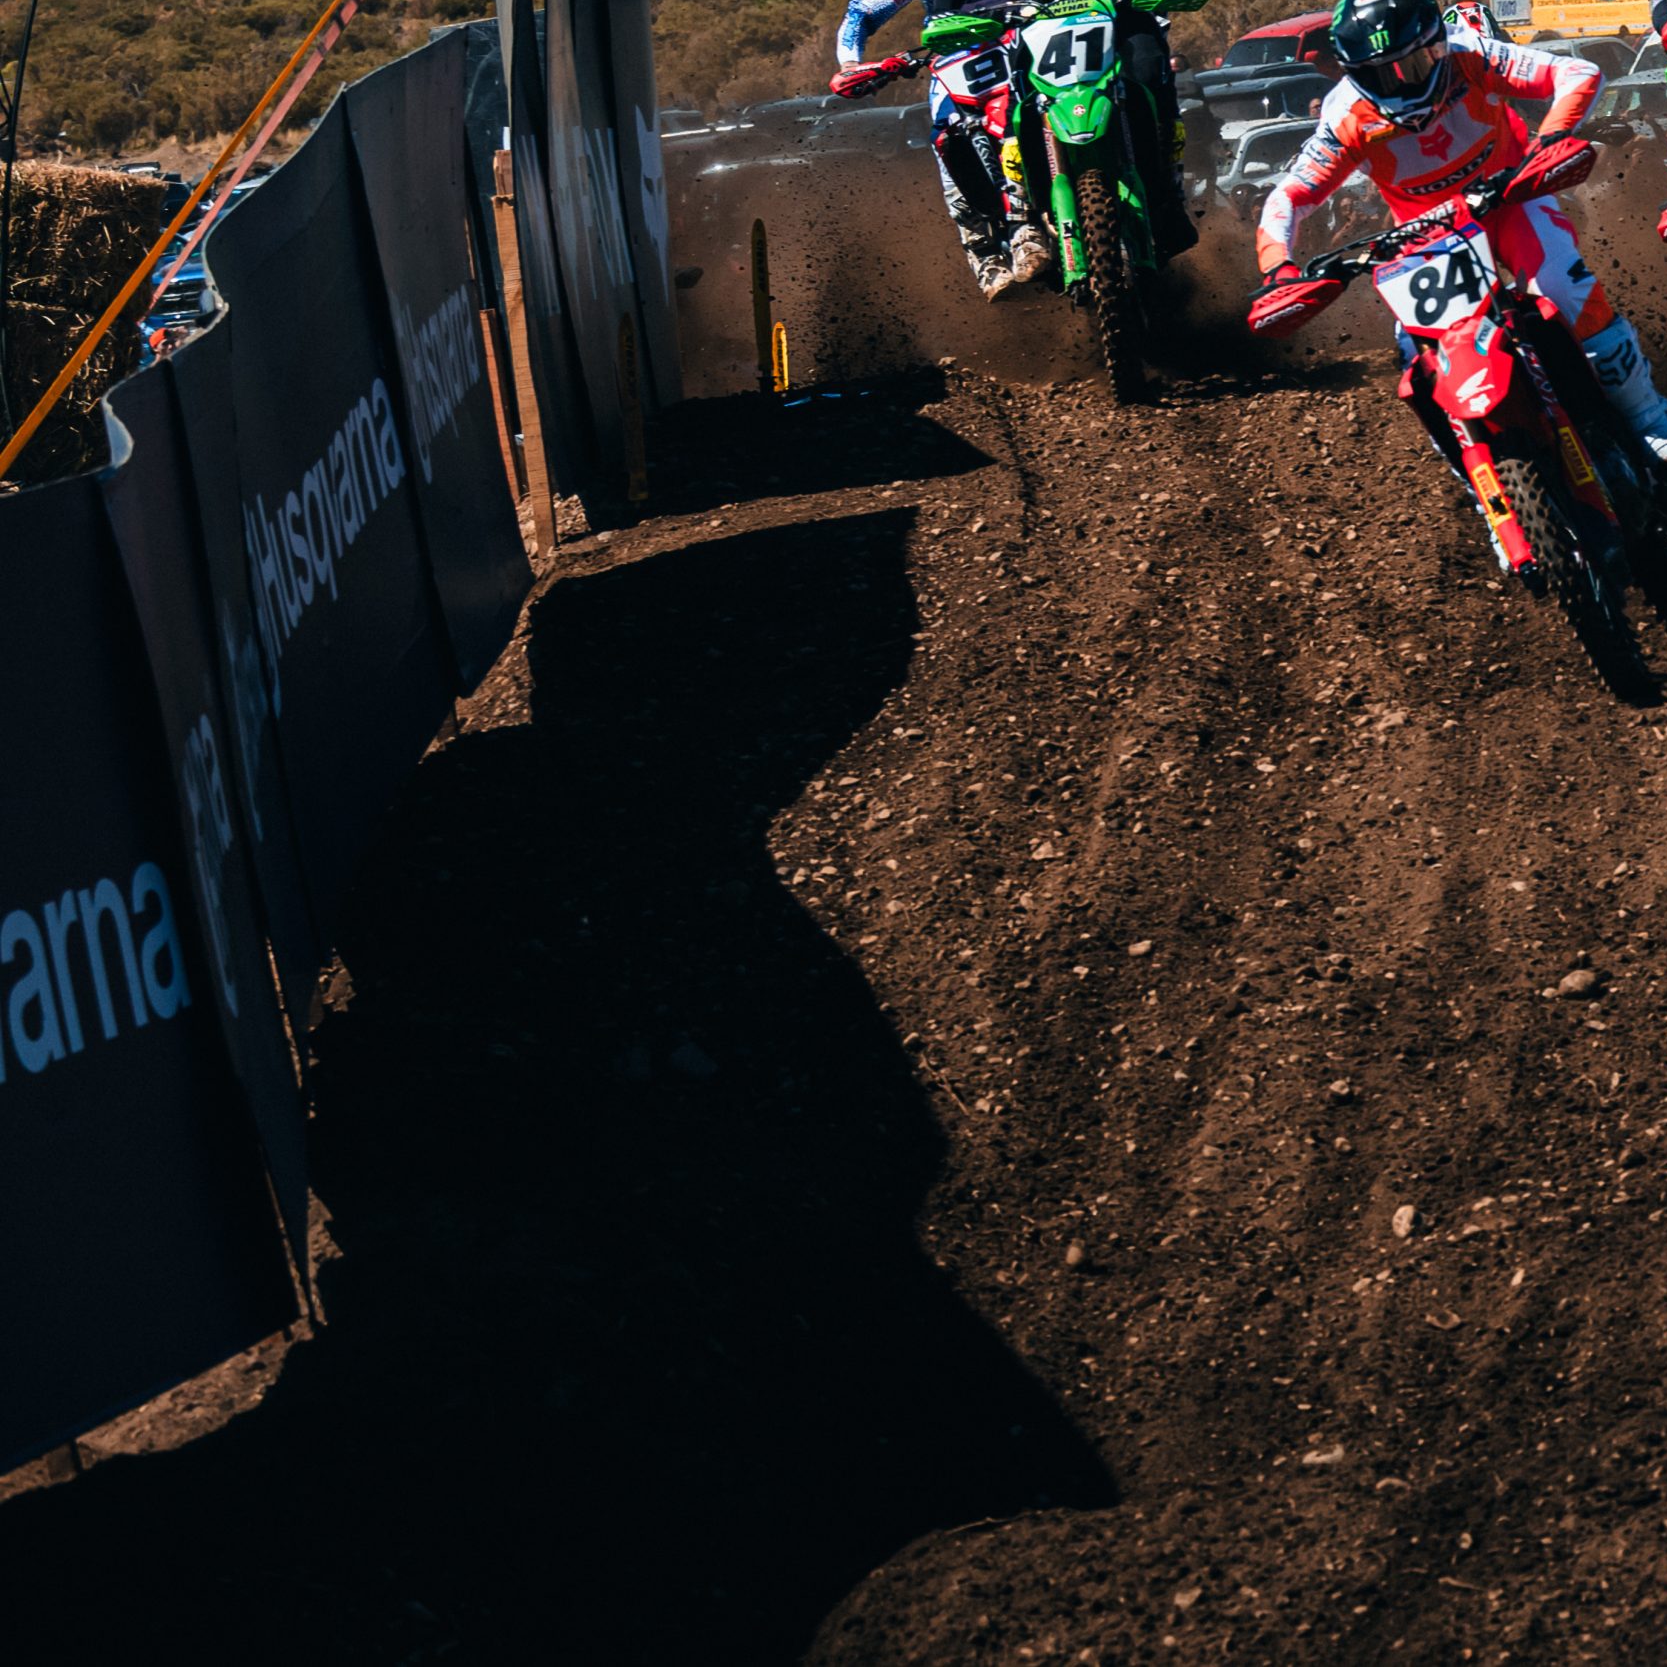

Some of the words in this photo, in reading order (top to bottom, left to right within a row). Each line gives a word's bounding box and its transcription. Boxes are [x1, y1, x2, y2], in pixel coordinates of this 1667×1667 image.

[1037, 25, 1105, 80] 41
[1406, 141, 1495, 195] HONDA
[1409, 248, 1483, 327] 84
[255, 377, 407, 656] Husqvarna
